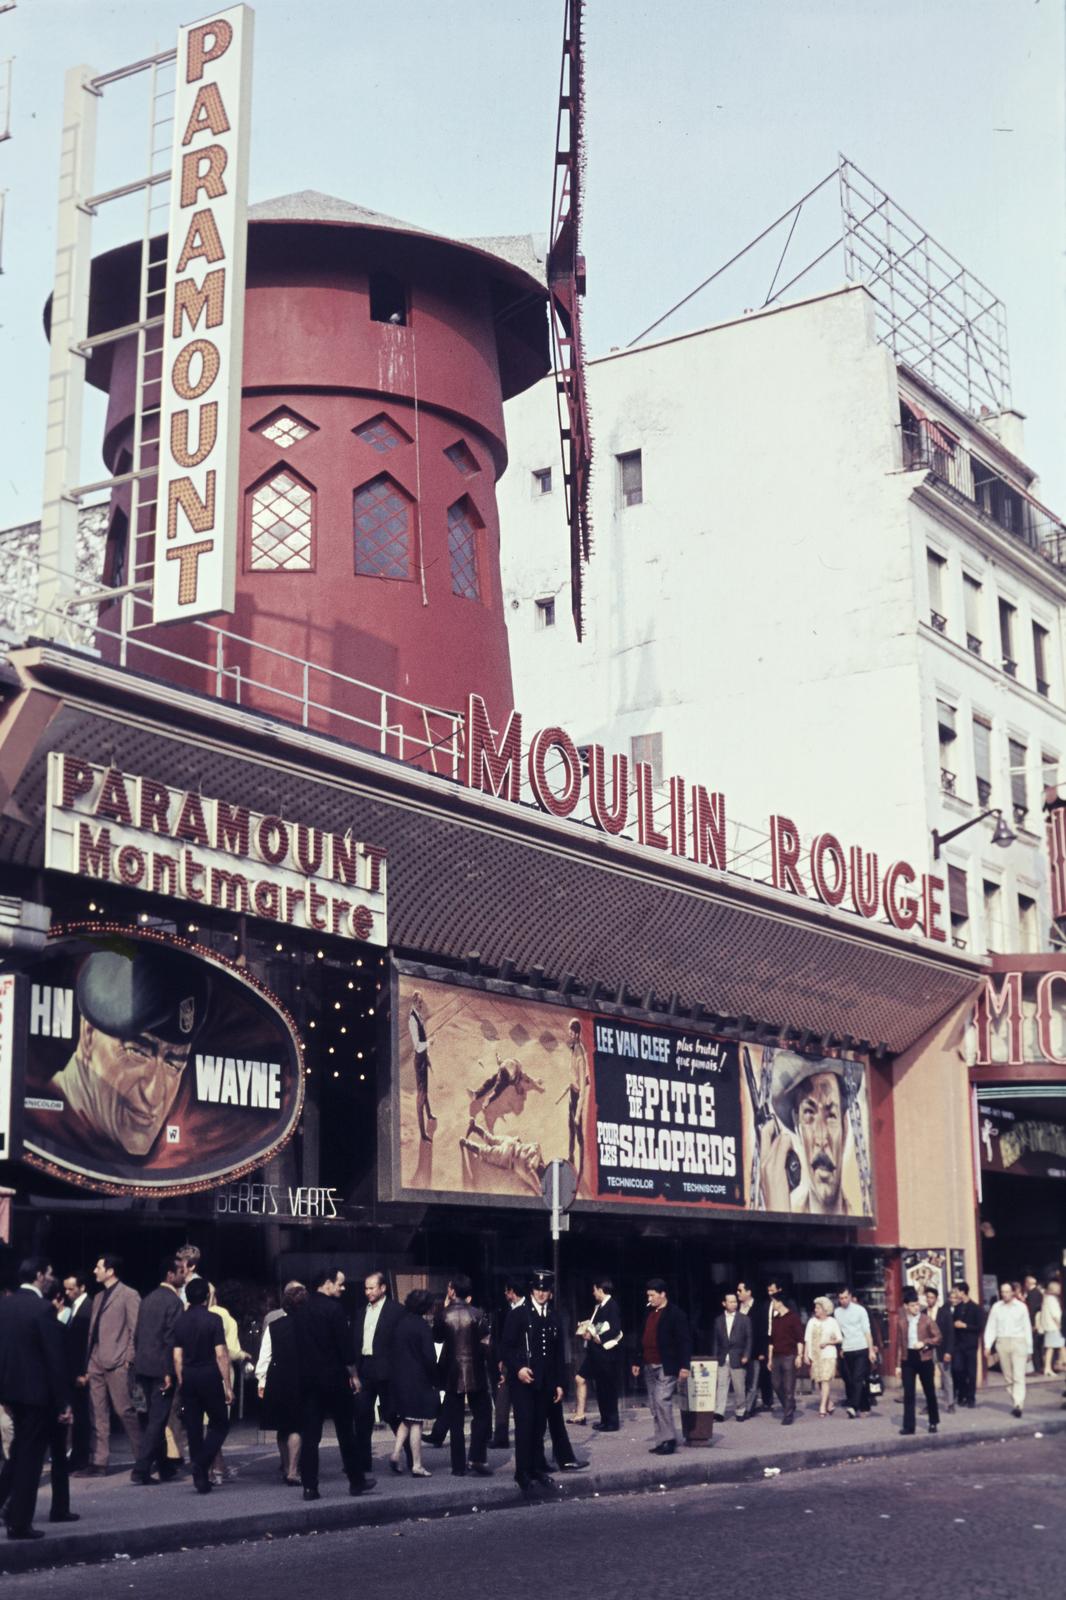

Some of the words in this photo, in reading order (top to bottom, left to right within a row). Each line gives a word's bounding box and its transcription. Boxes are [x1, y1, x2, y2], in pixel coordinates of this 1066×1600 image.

[166, 18, 233, 606] PARAMOUNT
[60, 755, 389, 891] PARAMOUNT
[465, 693, 727, 871] MOULIN
[770, 814, 947, 942] ROUGE
[75, 820, 375, 940] Montmartre
[596, 1026, 614, 1054] LEE
[616, 1029, 639, 1058] VAN
[641, 1034, 670, 1063] CLEEF
[676, 1036, 693, 1055] plus
[196, 1054, 281, 1109] WAYNE
[626, 1074, 644, 1097] PAS
[628, 1096, 643, 1119] DE
[644, 1076, 716, 1128] PITIÉ
[597, 1121, 620, 1146] POUR
[619, 1124, 737, 1177] SALOPARDS
[600, 1144, 618, 1166] LES
[288, 1186, 337, 1218] VERTS
[607, 1176, 654, 1189] TECHNICOLOR
[683, 1182, 727, 1195] TECHNISCOPE
